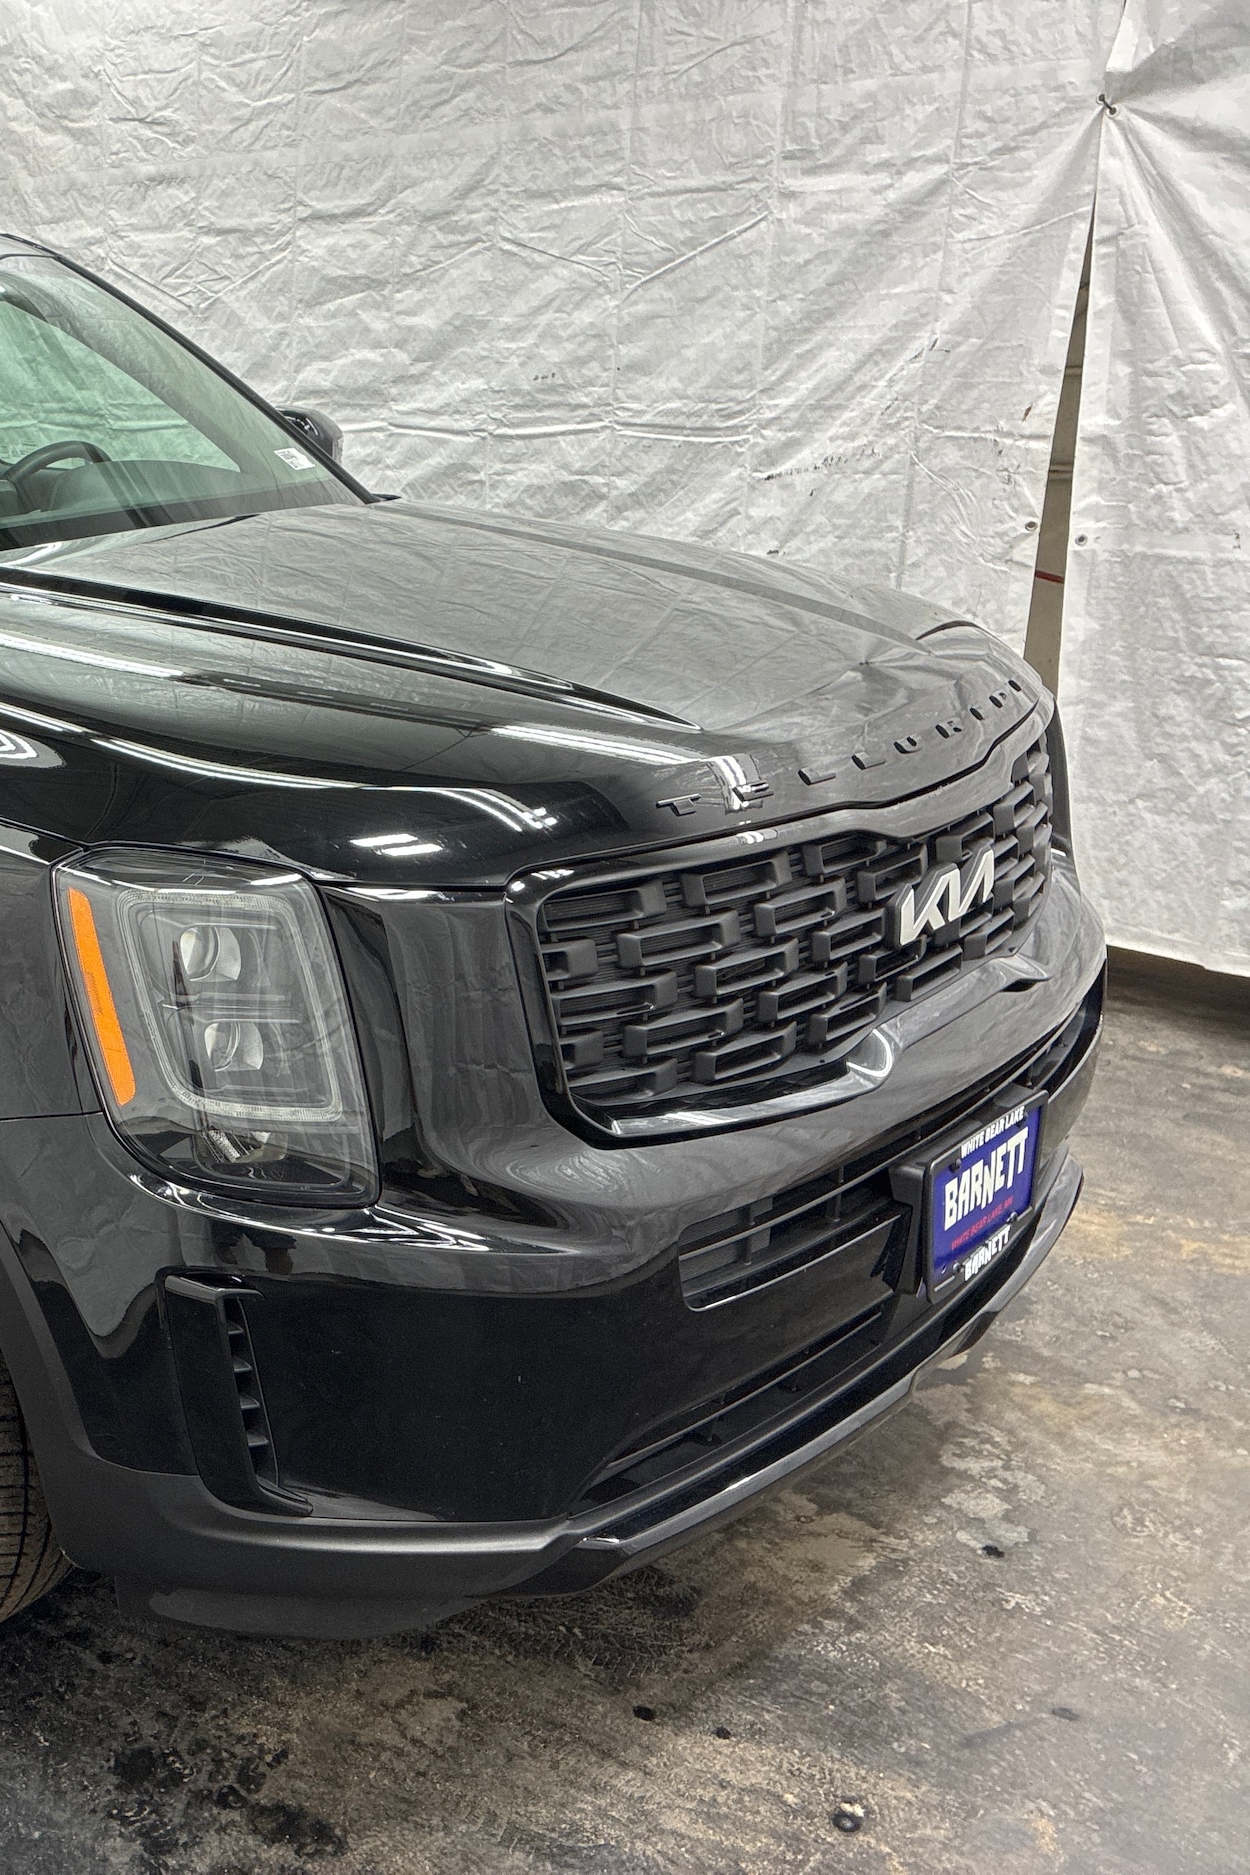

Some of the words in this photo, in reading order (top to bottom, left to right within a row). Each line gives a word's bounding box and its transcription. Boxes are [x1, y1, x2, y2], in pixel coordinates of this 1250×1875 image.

[961, 1130, 985, 1159] WHITE
[985, 1118, 1005, 1143] BEAR
[1005, 1105, 1025, 1130] LAKE
[944, 1126, 1029, 1231] BARNETT
[964, 1224, 1011, 1281] BARNETT
